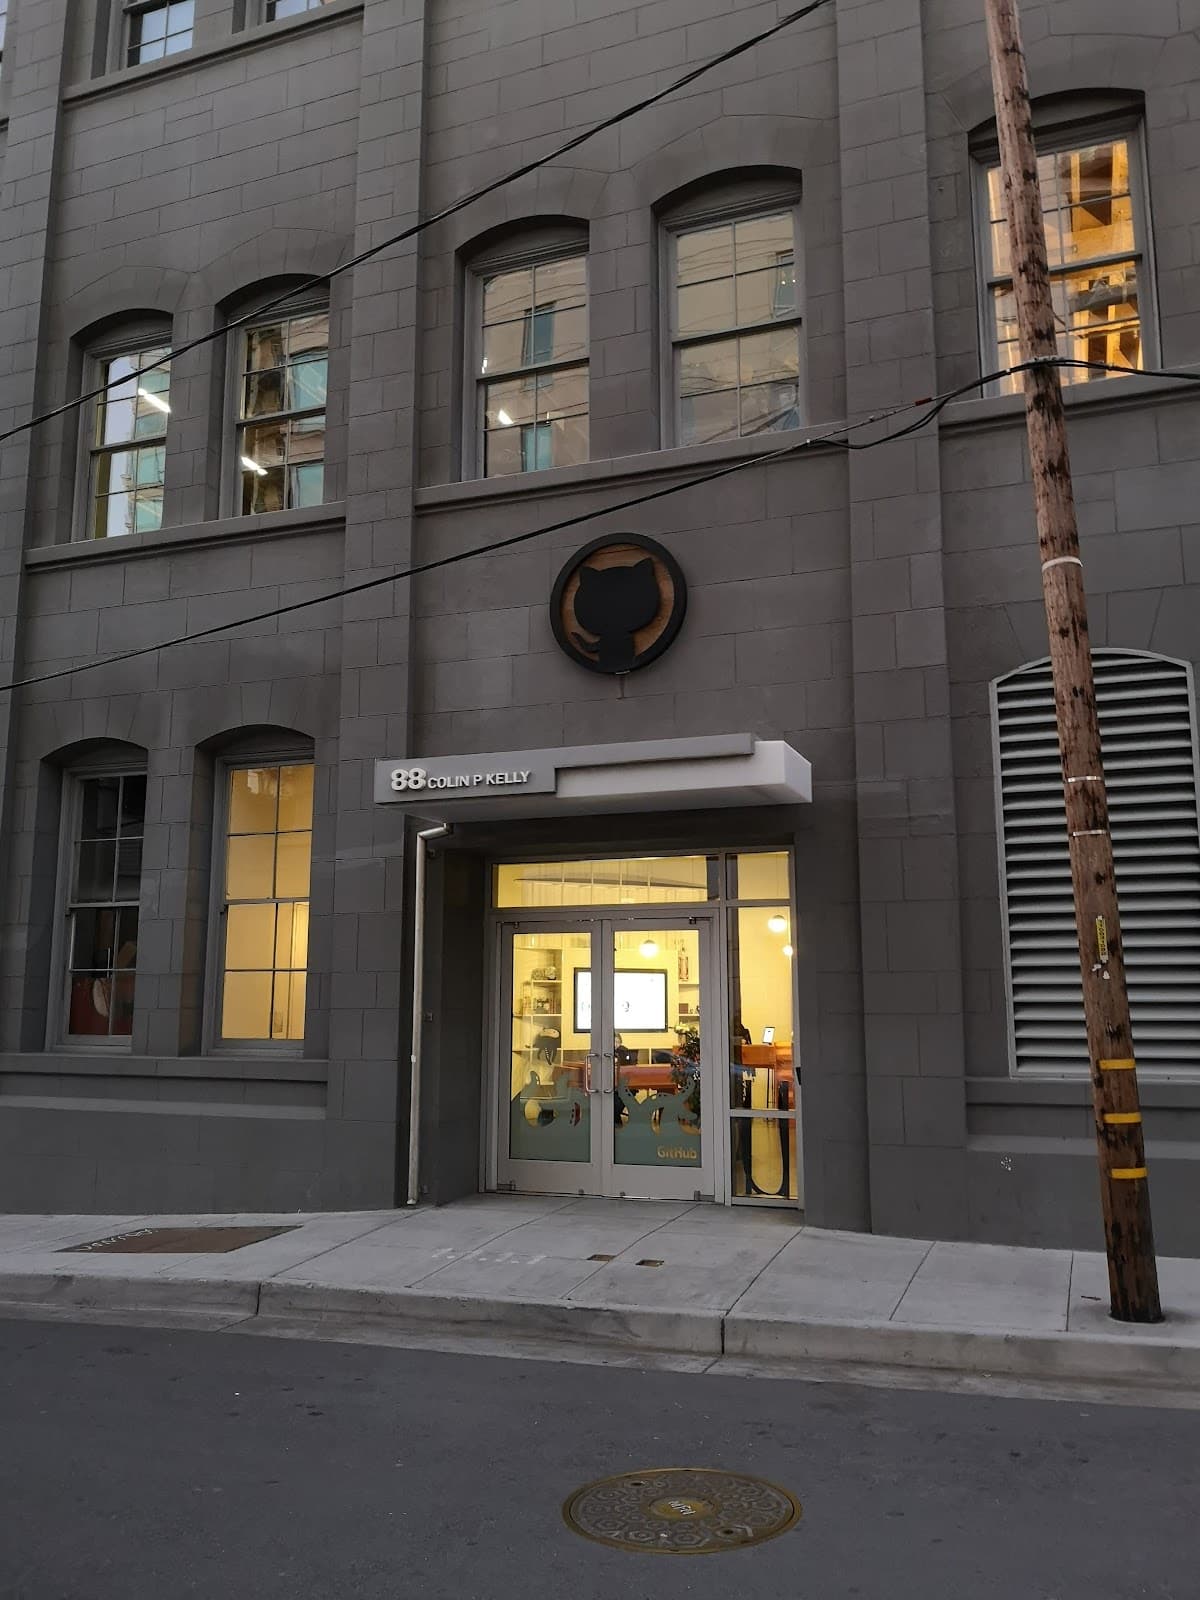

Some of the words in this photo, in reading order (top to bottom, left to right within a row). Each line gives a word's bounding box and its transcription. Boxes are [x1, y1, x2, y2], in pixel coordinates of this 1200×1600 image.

[391, 767, 427, 791] 88
[428, 776, 470, 789] COLIN
[473, 774, 483, 787] P
[486, 770, 532, 786] KELLY
[657, 1146, 697, 1159] GitHub
